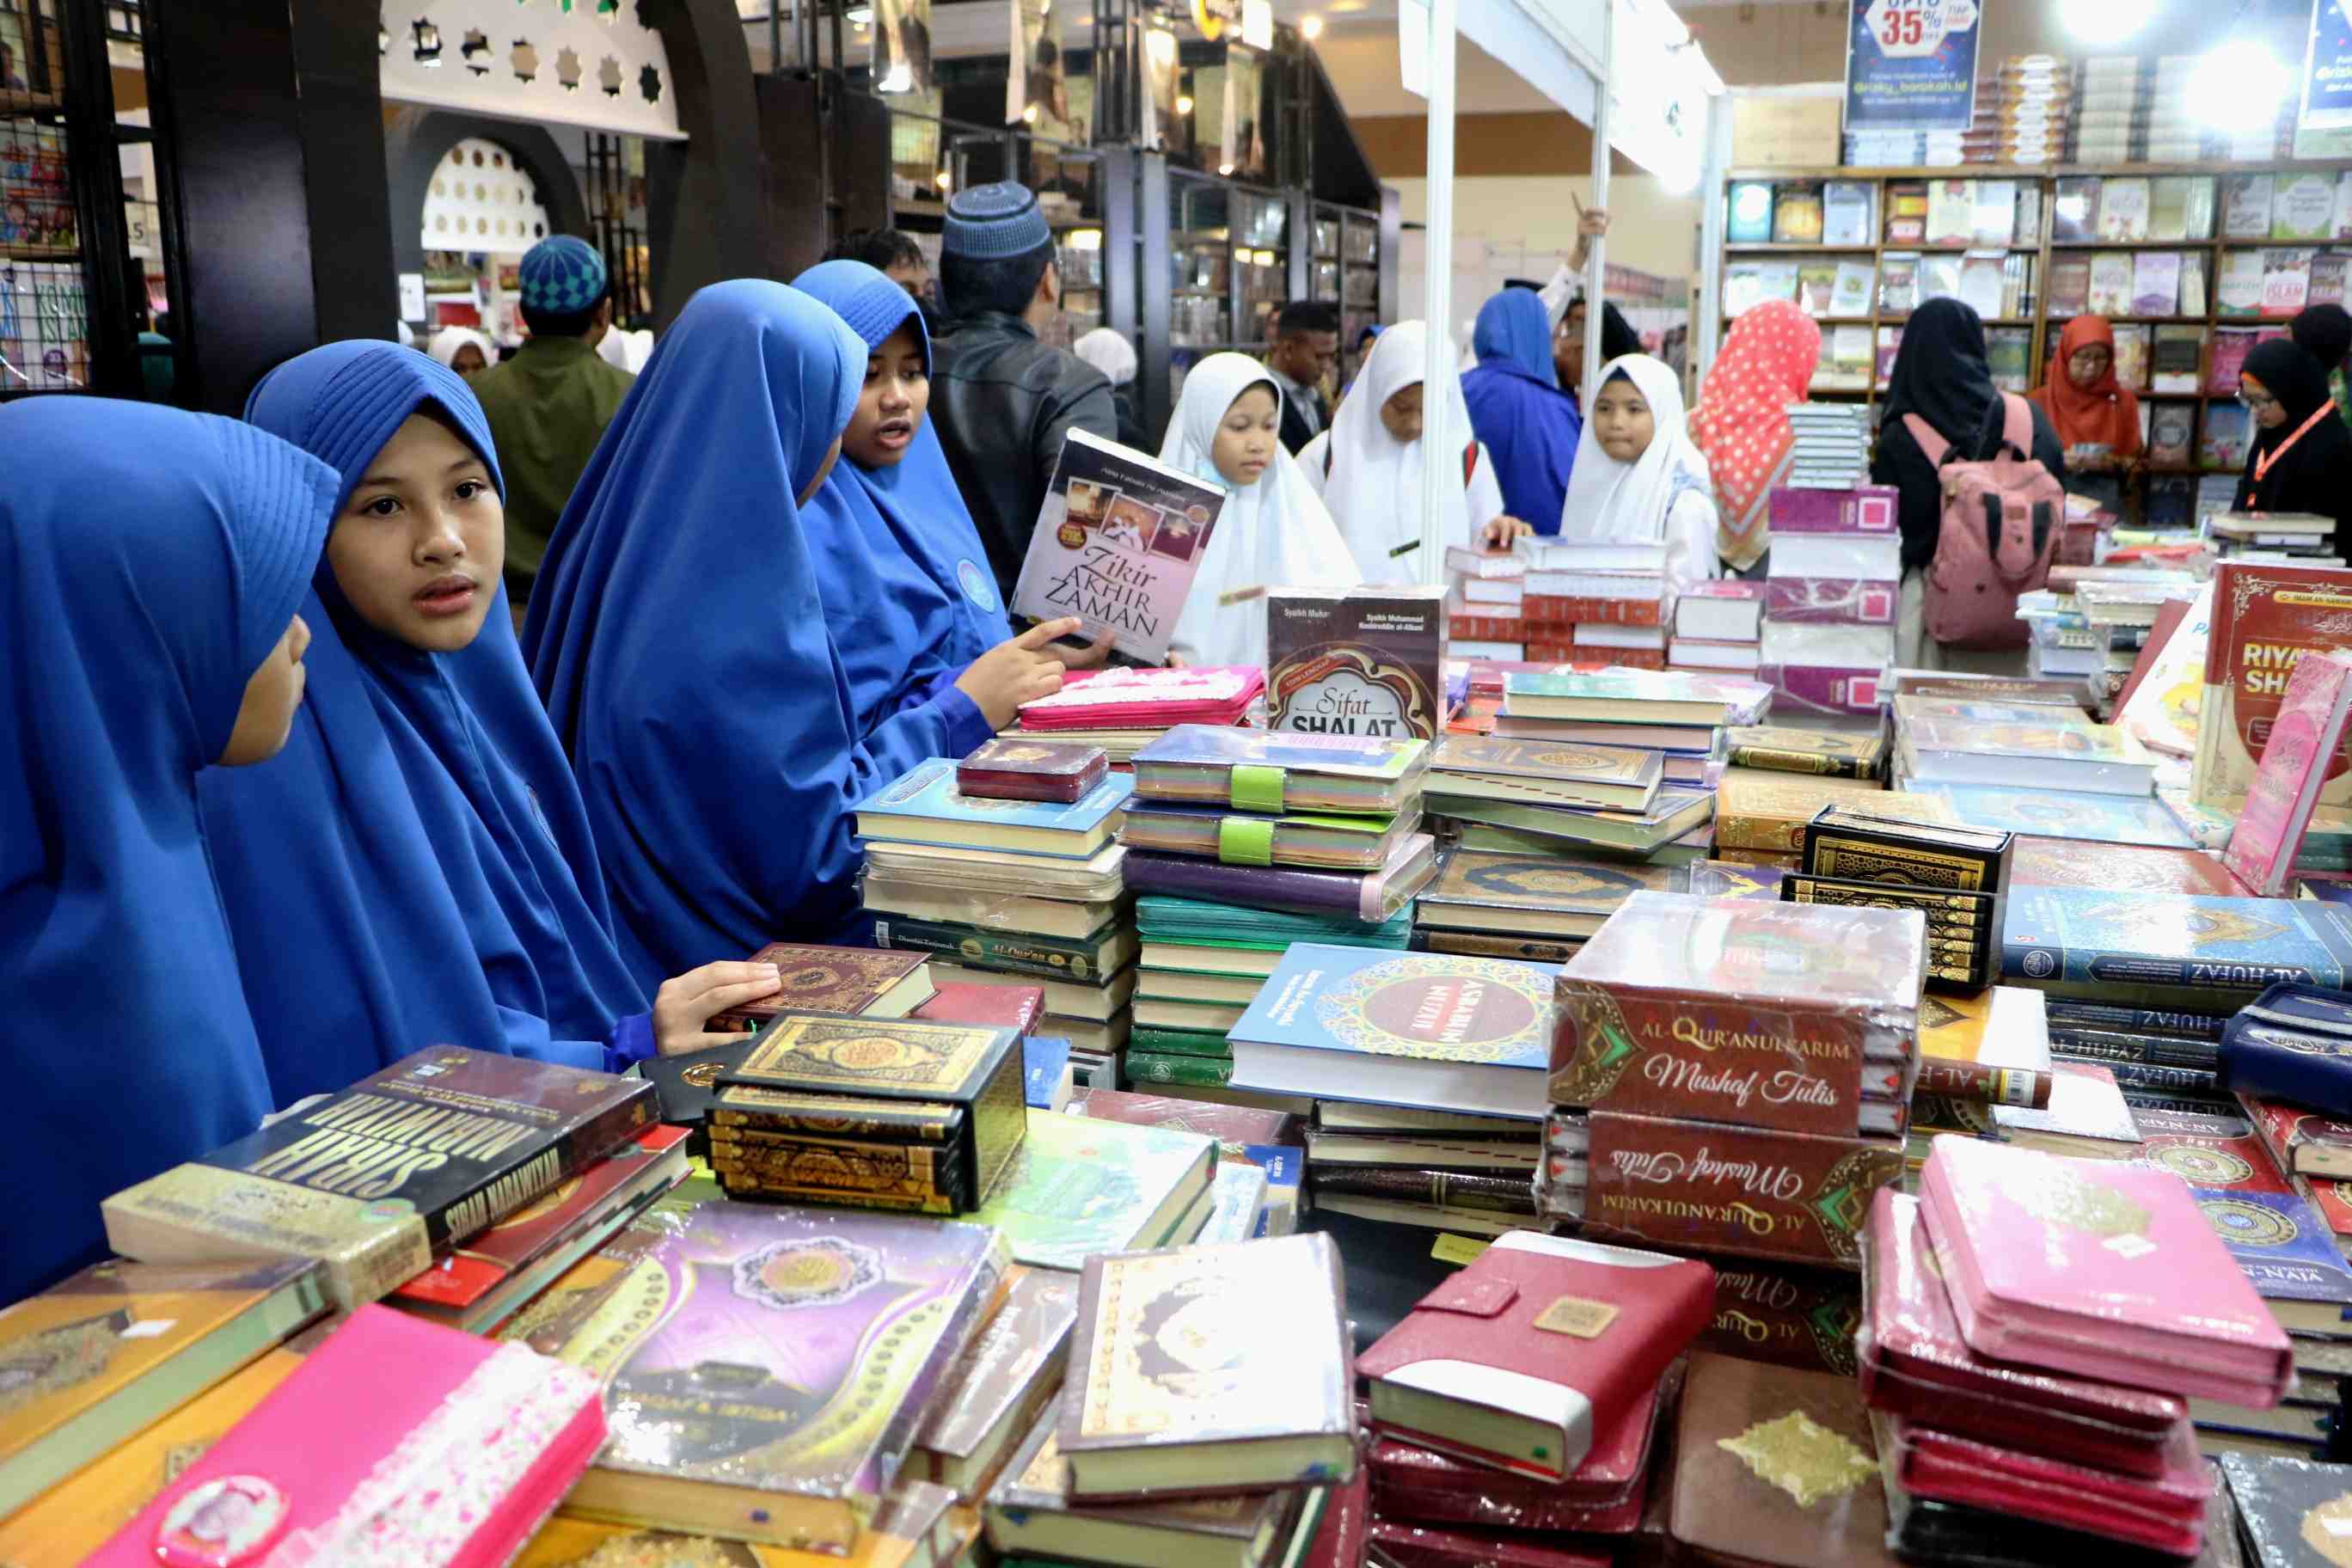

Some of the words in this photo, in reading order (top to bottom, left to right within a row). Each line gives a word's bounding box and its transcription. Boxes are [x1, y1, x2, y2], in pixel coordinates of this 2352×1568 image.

[1080, 546, 1158, 587] Zikir
[1044, 576, 1160, 638] ZAMAN
[1063, 566, 1150, 614] AKHIR
[2242, 643, 2302, 669] RIYA
[1316, 687, 1372, 723] Sifat
[1292, 715, 1397, 737] SHALAT
[2192, 964, 2302, 984] AL-HUFAZ
[2143, 1010, 2229, 1031] L-HUFAZ
[1644, 1052, 1759, 1107] Mushaf
[1761, 1069, 1840, 1107] Tulis
[1918, 1066, 1974, 1087] AL-H
[2128, 1065, 2217, 1087] L-HUFAZ
[303, 1093, 538, 1163] NABAWIYAH
[247, 1127, 448, 1197] SIRAH
[1609, 1149, 1685, 1184] Tulis
[1690, 1146, 1804, 1200] Mushaf
[445, 1197, 488, 1245] SIRAH
[486, 1146, 561, 1221] NABAWIYAH
[1714, 1271, 1798, 1308] Mush
[1712, 1309, 1799, 1342] AL-QUR'
